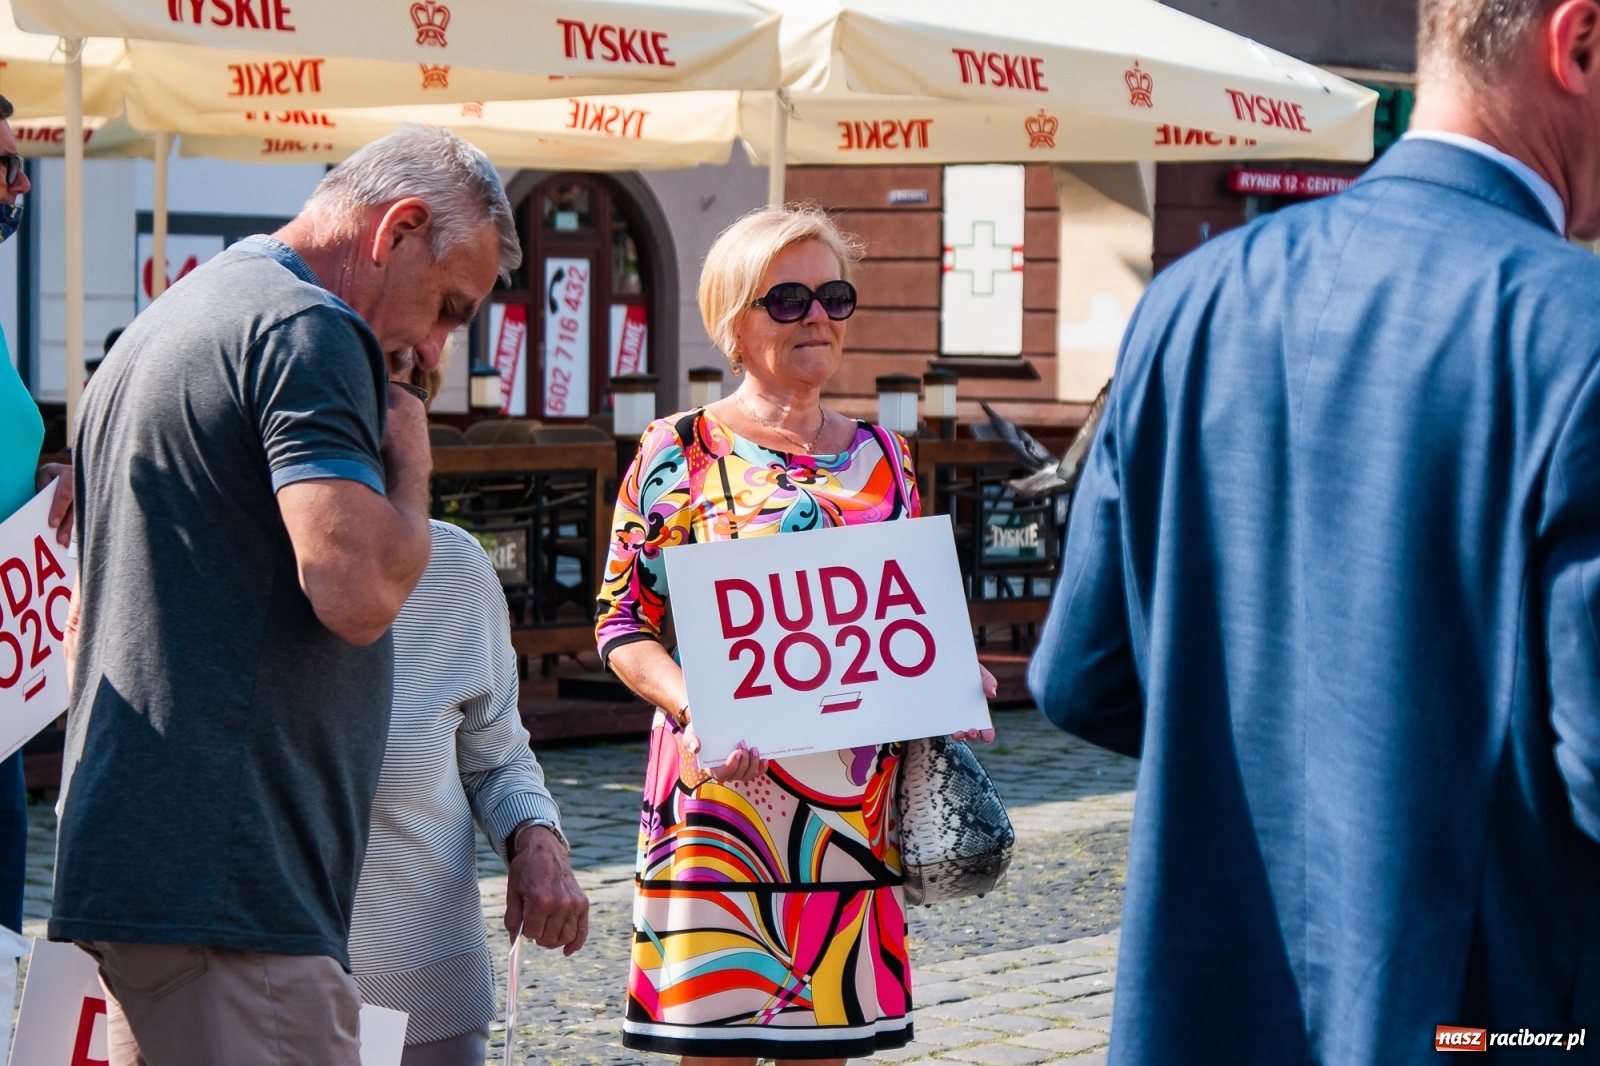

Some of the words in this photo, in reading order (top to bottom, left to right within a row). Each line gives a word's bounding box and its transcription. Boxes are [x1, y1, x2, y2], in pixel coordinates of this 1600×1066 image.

[556, 18, 676, 67] TYSKIE
[952, 48, 1049, 92] TYSKIE
[1225, 88, 1312, 133] TYSKIE
[1241, 171, 1281, 189] RYNEK
[1285, 174, 1298, 190] 12
[564, 265, 588, 312] 432
[555, 317, 580, 362] 716
[547, 366, 572, 416] 602
[991, 522, 1039, 548] TYSKIE
[0, 534, 66, 628] DA
[714, 559, 926, 640] DUDA
[729, 618, 936, 700] 2020
